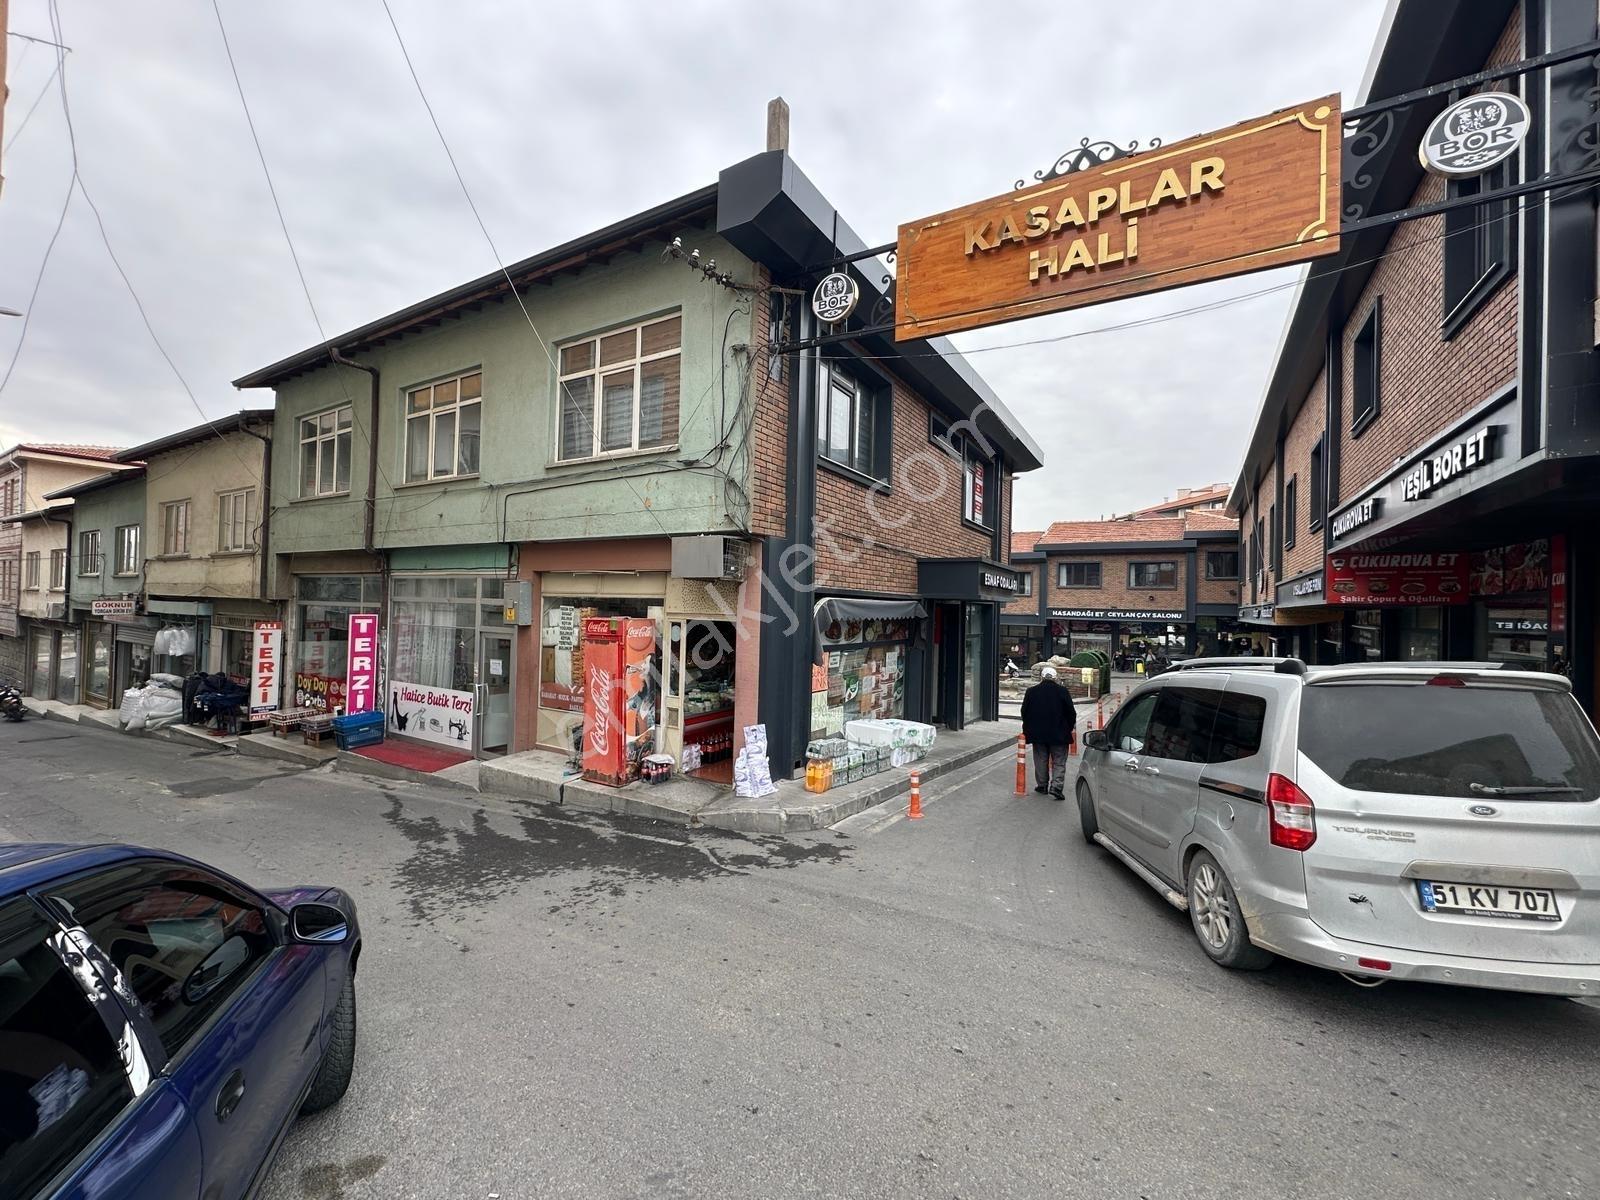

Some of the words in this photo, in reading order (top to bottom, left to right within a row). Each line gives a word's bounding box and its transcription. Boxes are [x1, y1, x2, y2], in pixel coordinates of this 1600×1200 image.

[1440, 126, 1514, 157] BOR
[963, 156, 1226, 256] KASAPLAR
[1028, 216, 1140, 282] HALİ
[818, 295, 849, 310] BOR
[1400, 461, 1431, 501] YEŞİL
[1433, 444, 1462, 485] BOR
[1465, 427, 1488, 468] ET
[1332, 504, 1363, 541] ÇUKUROVA
[1363, 499, 1373, 522] ET
[1436, 553, 1460, 566] ET
[984, 573, 1000, 588] ESNAF
[1000, 576, 1018, 591] ODALARI
[1340, 595, 1365, 604] Şakir
[1367, 595, 1396, 604] Çopur
[1408, 594, 1451, 604] Oğulları
[258, 632, 275, 703] TERZİ
[351, 618, 373, 709] TERZİ
[297, 674, 313, 692] Doy
[313, 677, 329, 695] Doy
[401, 687, 426, 704] Hatice
[427, 691, 450, 709] Butik
[451, 695, 473, 714] Terzi
[1332, 826, 1415, 838] TOURNEO
[1432, 885, 1459, 906] 51
[1467, 887, 1499, 908] KV
[1508, 890, 1549, 912] 707
